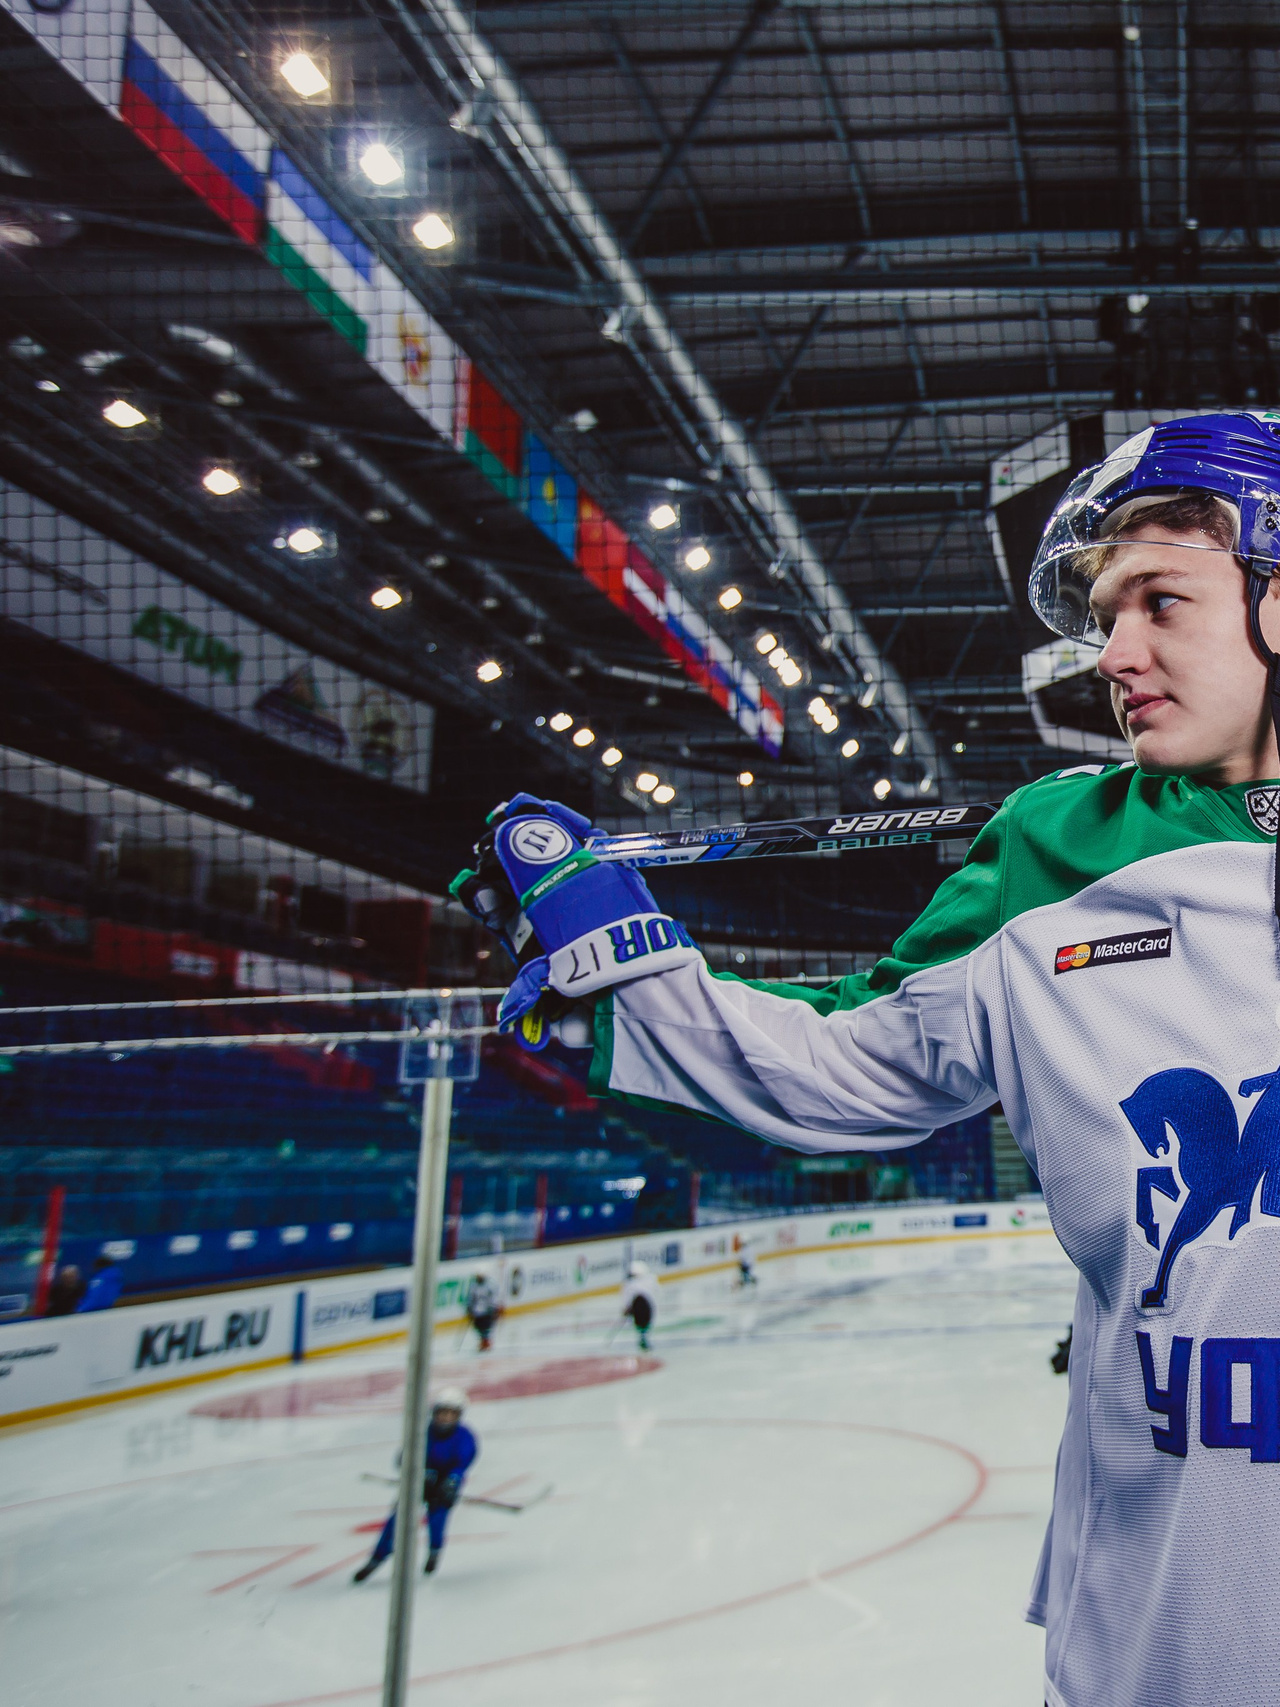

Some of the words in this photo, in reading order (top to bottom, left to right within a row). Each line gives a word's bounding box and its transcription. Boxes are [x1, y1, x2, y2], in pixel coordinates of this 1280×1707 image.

[827, 807, 969, 834] BAUER
[566, 942, 601, 985] 17
[1093, 935, 1170, 959] MasterCard
[134, 1305, 273, 1370] KHL.RU
